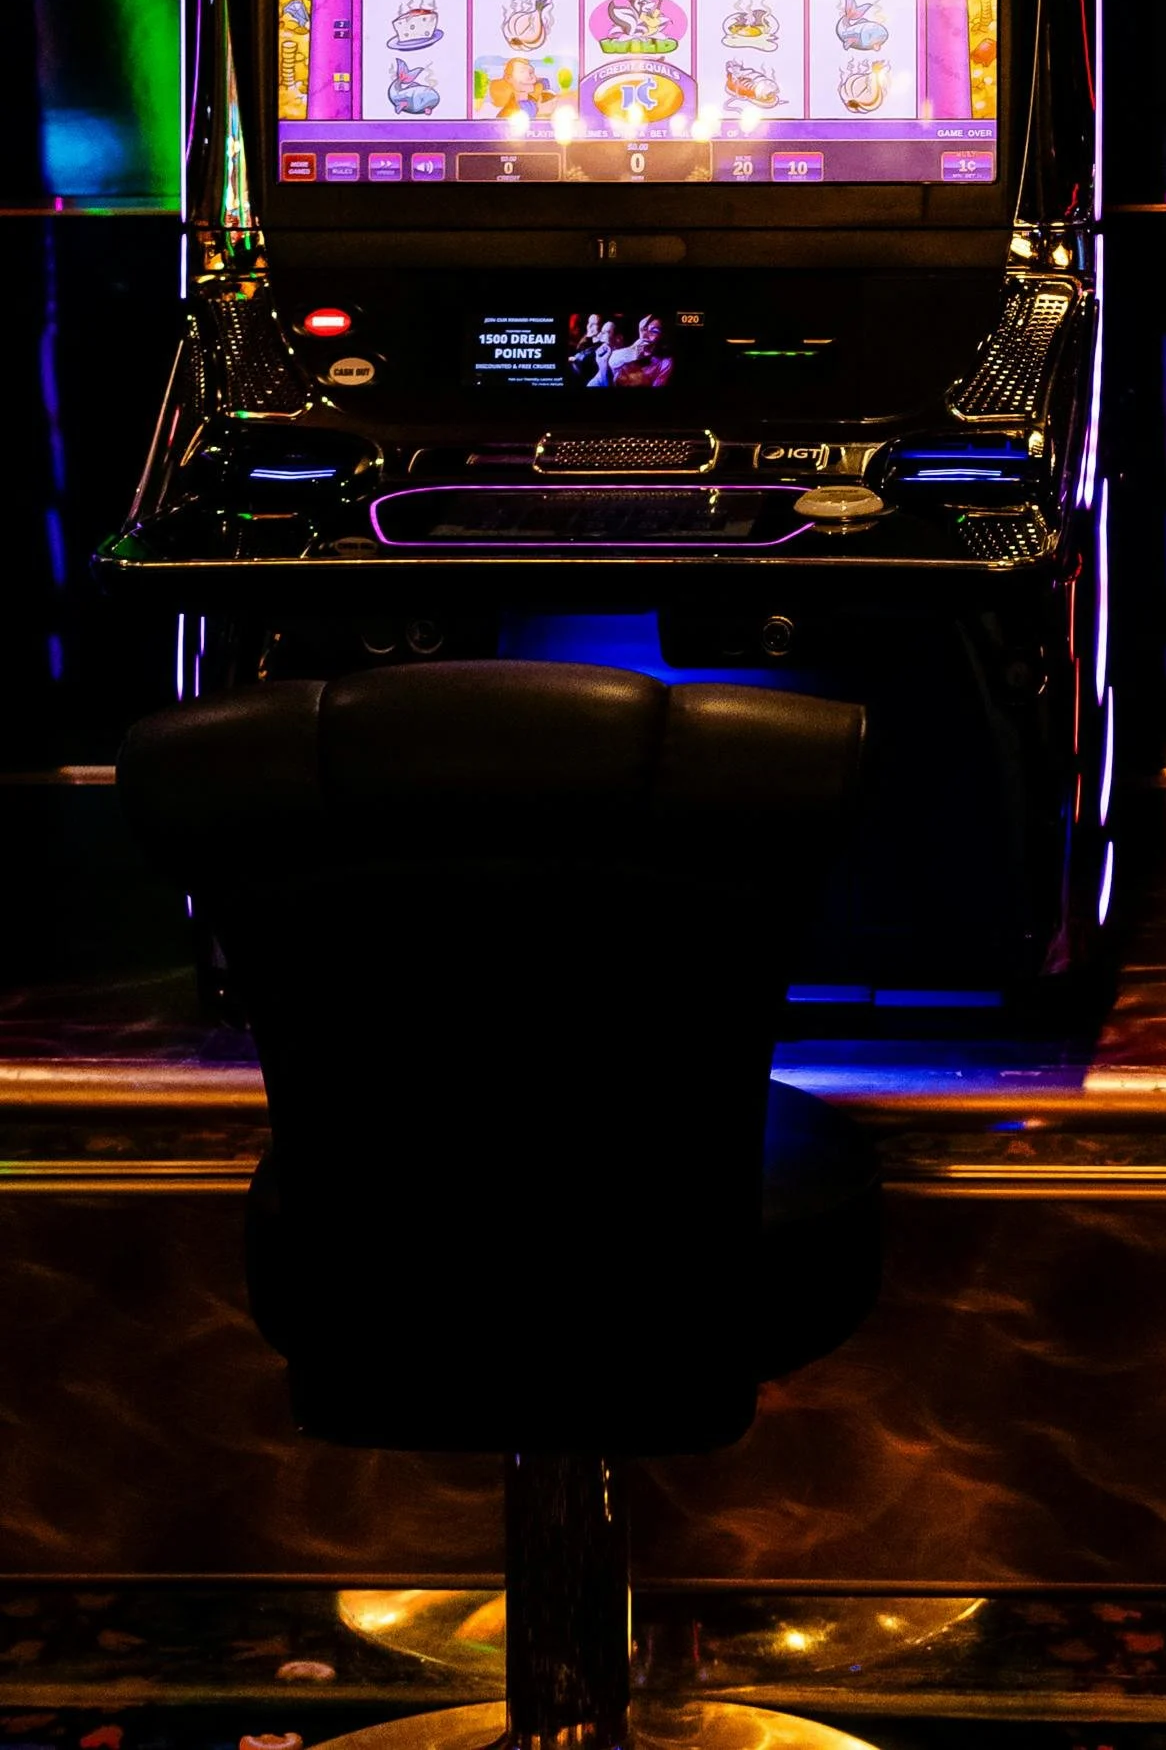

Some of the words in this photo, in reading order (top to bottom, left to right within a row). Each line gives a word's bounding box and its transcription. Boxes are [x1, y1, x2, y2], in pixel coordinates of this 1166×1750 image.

[600, 38, 678, 54] WILD
[599, 62, 637, 80] CREDIT
[640, 62, 681, 81] EQUALS
[630, 153, 645, 173] 0
[733, 161, 753, 175] 20
[788, 161, 808, 175] 10
[681, 315, 699, 324] 020
[479, 334, 508, 344] 1500
[511, 334, 556, 344] DREAM
[495, 348, 542, 359] POINTS
[334, 368, 353, 376] CASH
[356, 368, 370, 376] OUT
[788, 448, 823, 459] IGT
